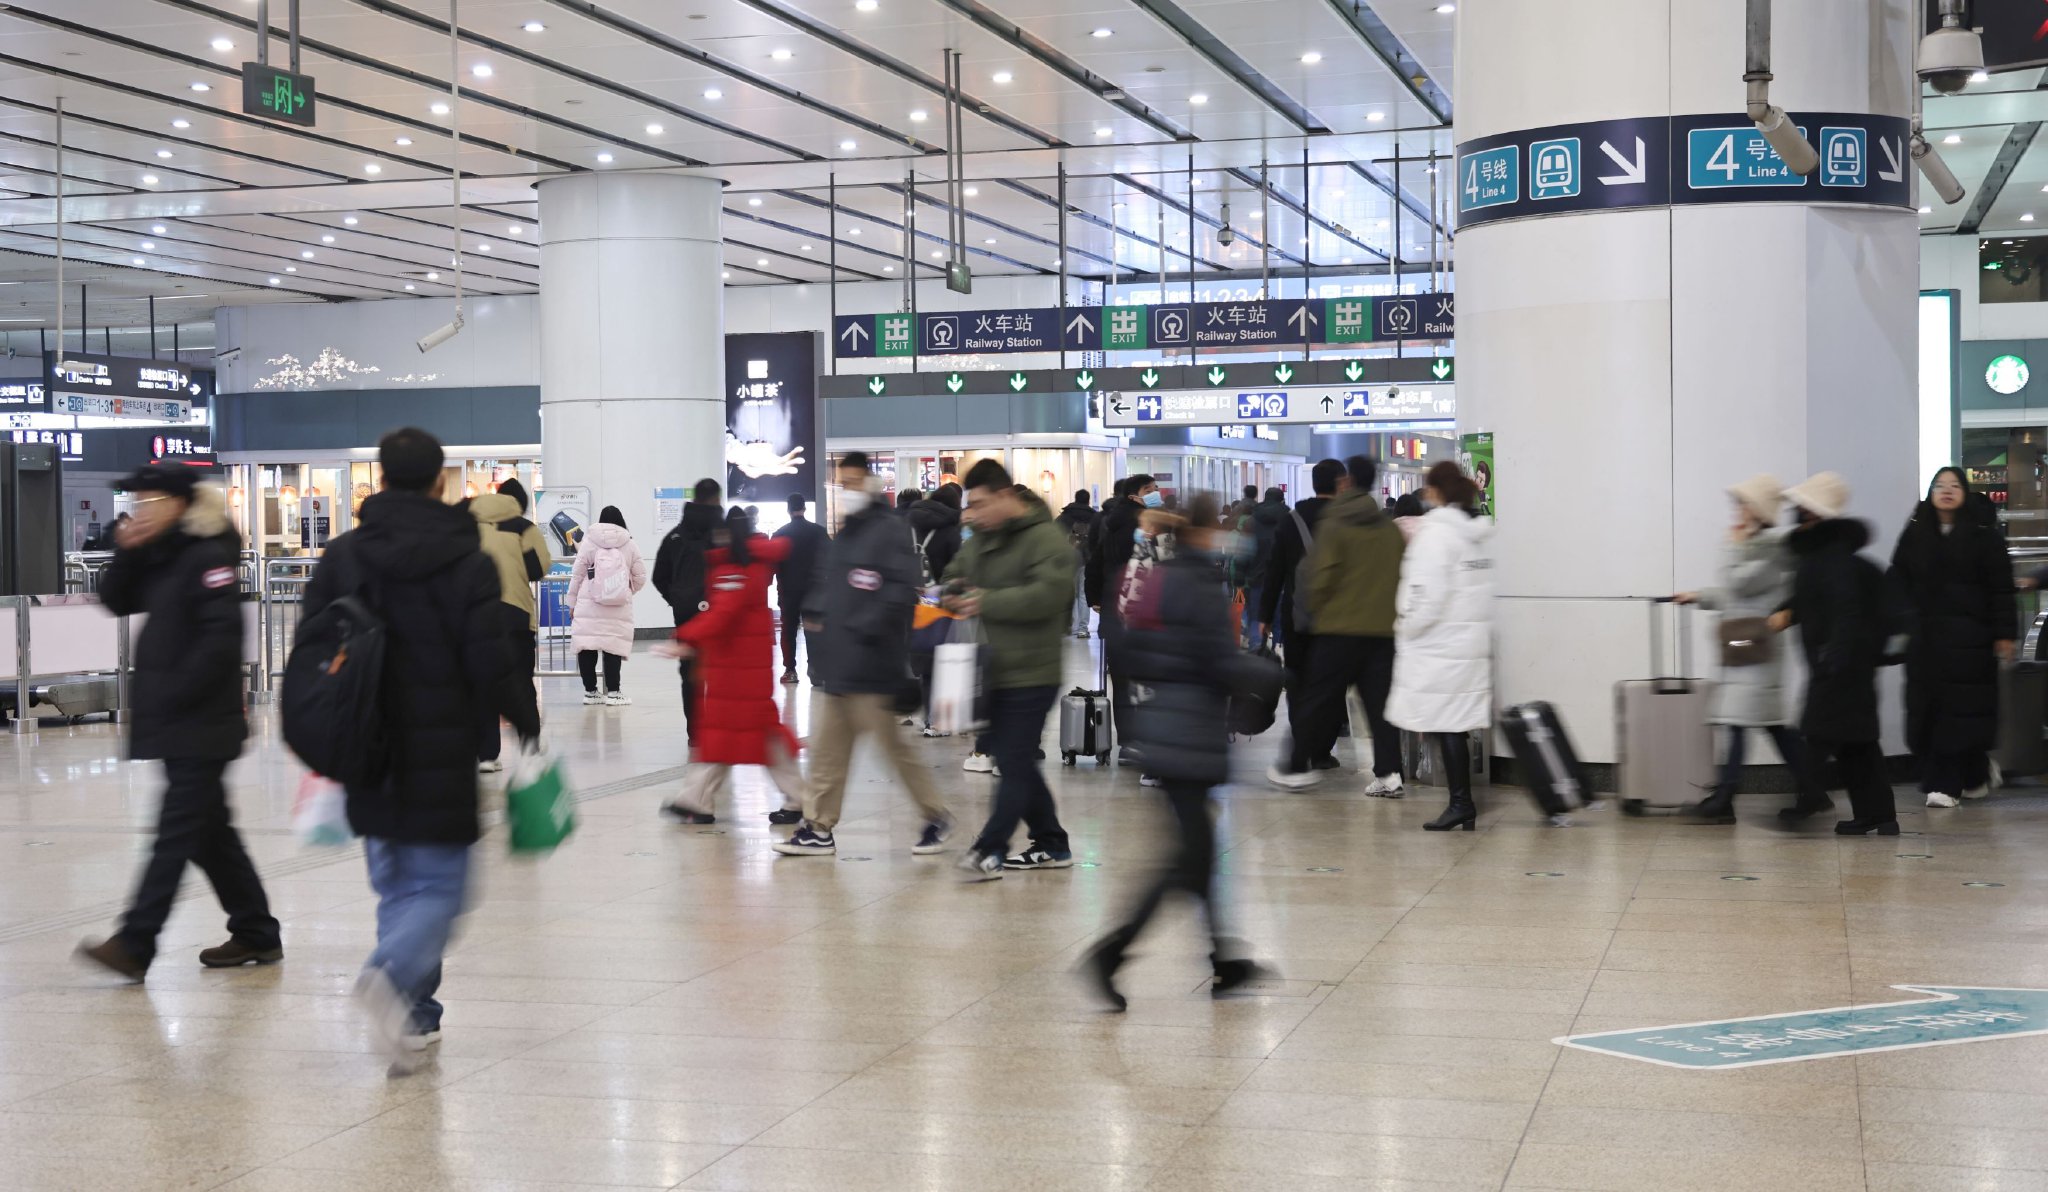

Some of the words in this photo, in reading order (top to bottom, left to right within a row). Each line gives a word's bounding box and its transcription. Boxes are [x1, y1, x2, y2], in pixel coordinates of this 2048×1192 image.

[1706, 134, 1740, 181] 4
[1749, 166, 1777, 178] Line
[1780, 166, 1788, 177] 4
[1465, 159, 1479, 203] 4
[1481, 158, 1508, 182] 号线
[1482, 186, 1499, 199] Line
[1500, 184, 1506, 195] 4
[1206, 305, 1268, 326] 火车站
[975, 313, 1034, 334] 火车站
[1335, 326, 1362, 335] EXIT
[965, 338, 1004, 350] Railway
[1006, 336, 1042, 348] Station
[1111, 334, 1137, 343] EXIT
[1196, 331, 1237, 343] Railway
[1239, 329, 1277, 340] Station
[884, 341, 908, 350] EXIT
[736, 383, 779, 399] 小罐茶
[167, 439, 192, 454] 李先生
[604, 570, 627, 593] NIKE
[1635, 1035, 1714, 1053] Line
